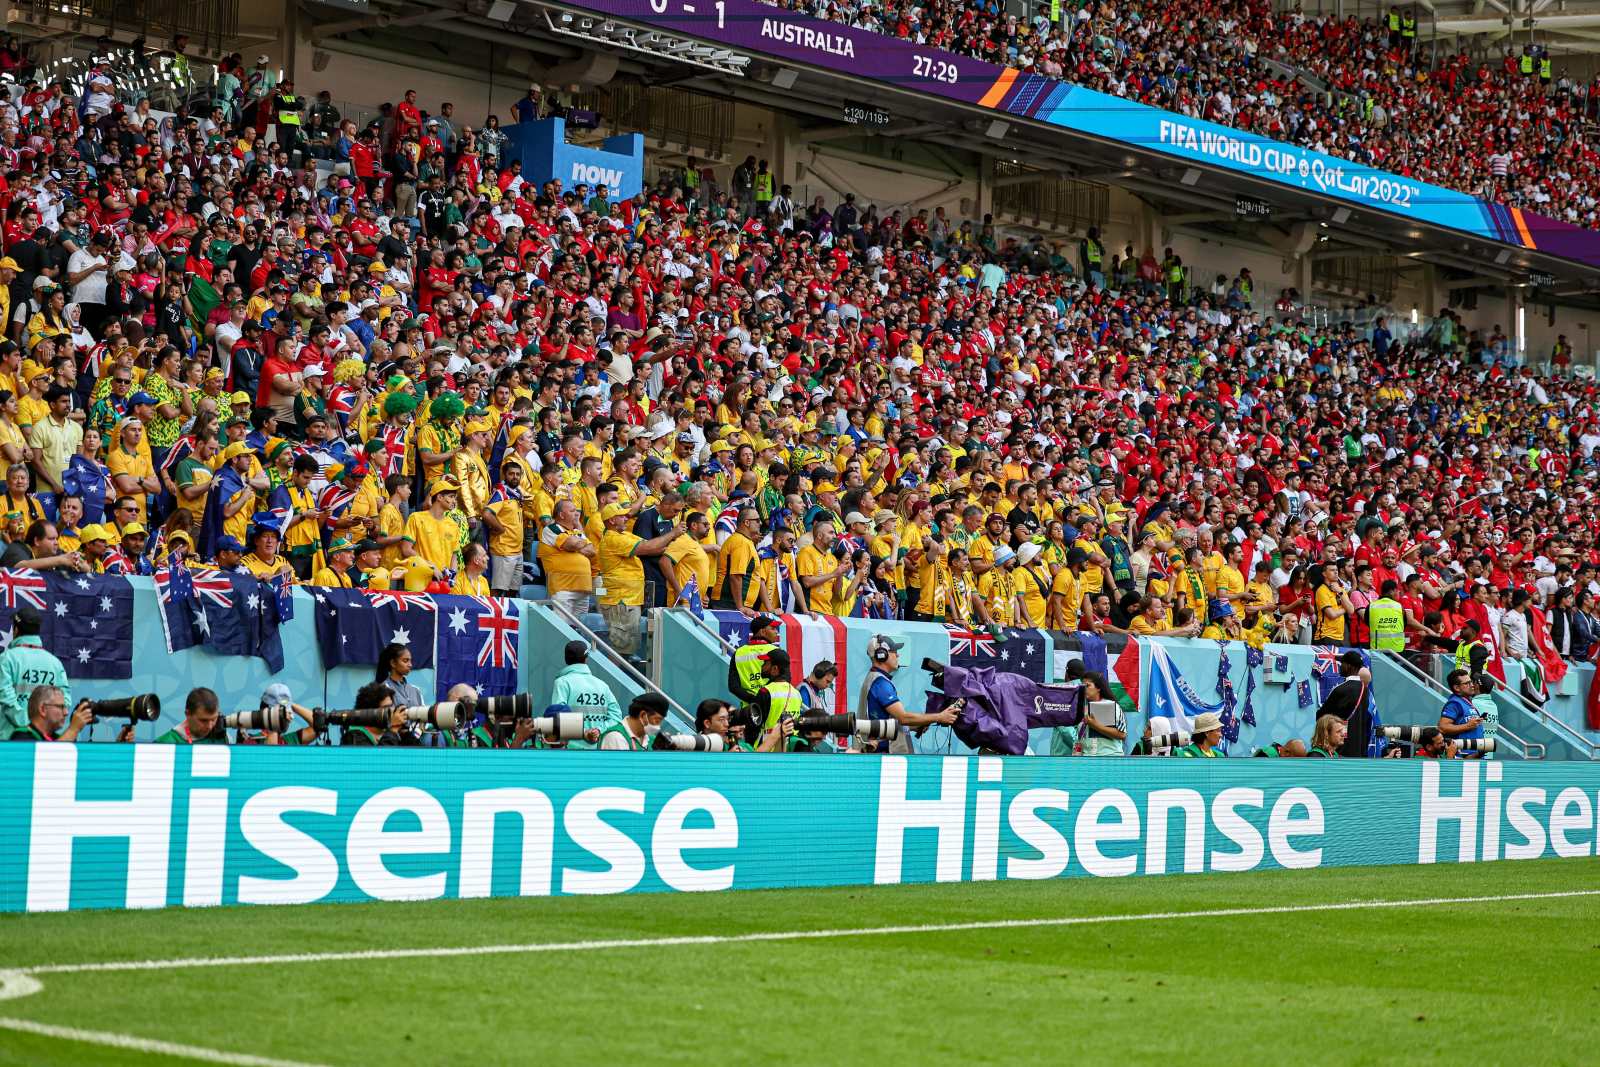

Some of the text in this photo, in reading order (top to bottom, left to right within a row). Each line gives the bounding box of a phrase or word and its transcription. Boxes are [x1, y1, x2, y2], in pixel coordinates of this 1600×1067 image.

[715, 1, 725, 29] 1
[761, 18, 855, 58] AUSTRALIA
[913, 55, 958, 84] 27:29
[1160, 120, 1199, 151] FIFA
[1200, 130, 1262, 167] WORLD
[1264, 148, 1297, 175] CUP
[571, 162, 623, 188] now
[22, 669, 55, 686] 4372
[576, 693, 606, 706] 4236
[27, 743, 739, 913] Hisense
[873, 755, 1325, 886] Hisense
[1418, 761, 1600, 865] Hise
